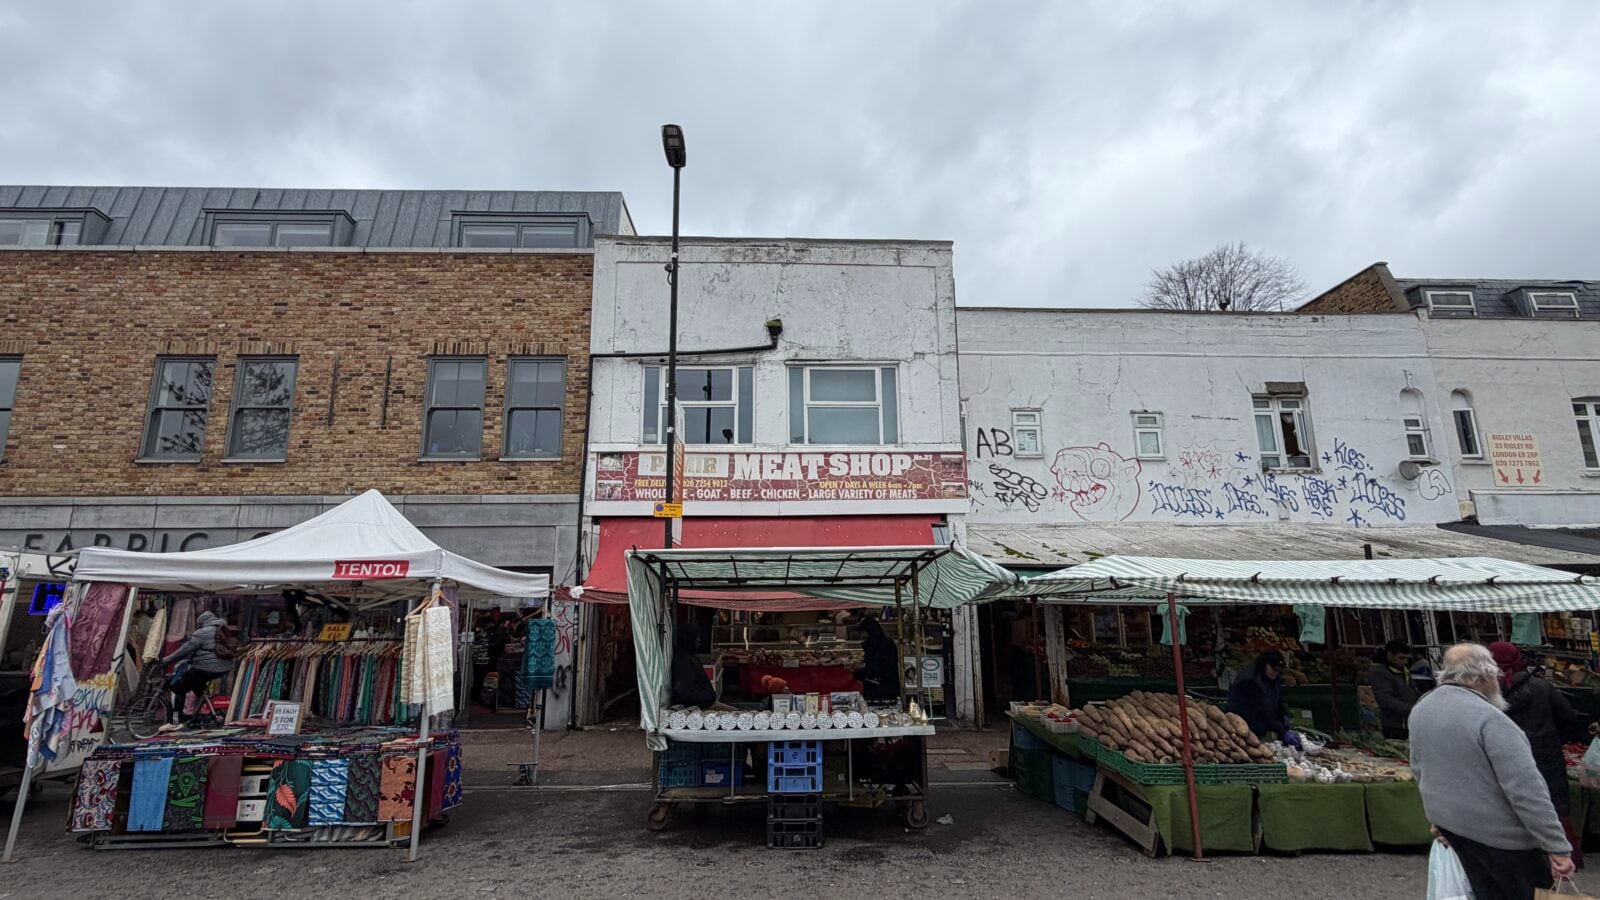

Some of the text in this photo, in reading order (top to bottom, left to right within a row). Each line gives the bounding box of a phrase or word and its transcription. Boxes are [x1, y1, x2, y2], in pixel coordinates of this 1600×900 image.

[976, 427, 1014, 458] AB
[650, 453, 912, 480] PMIR MEAT SHOP
[634, 479, 650, 488] FREE
[820, 481, 838, 489] OPEN
[839, 481, 844, 489] 7
[845, 481, 861, 489] DAYS
[862, 481, 868, 489] A
[868, 481, 887, 489] WEEK
[908, 481, 923, 491] 7pm
[635, 488, 688, 499] WHOLEE
[696, 488, 721, 499] GOAT
[730, 489, 753, 499] BEEF
[761, 488, 800, 499] CHICKEN
[809, 489, 836, 499] LARGE
[838, 489, 873, 499] VARIETY
[875, 489, 888, 499] OF
[889, 489, 918, 499] MEATS
[339, 563, 404, 576] TENTOL
[280, 716, 294, 724] FOR
